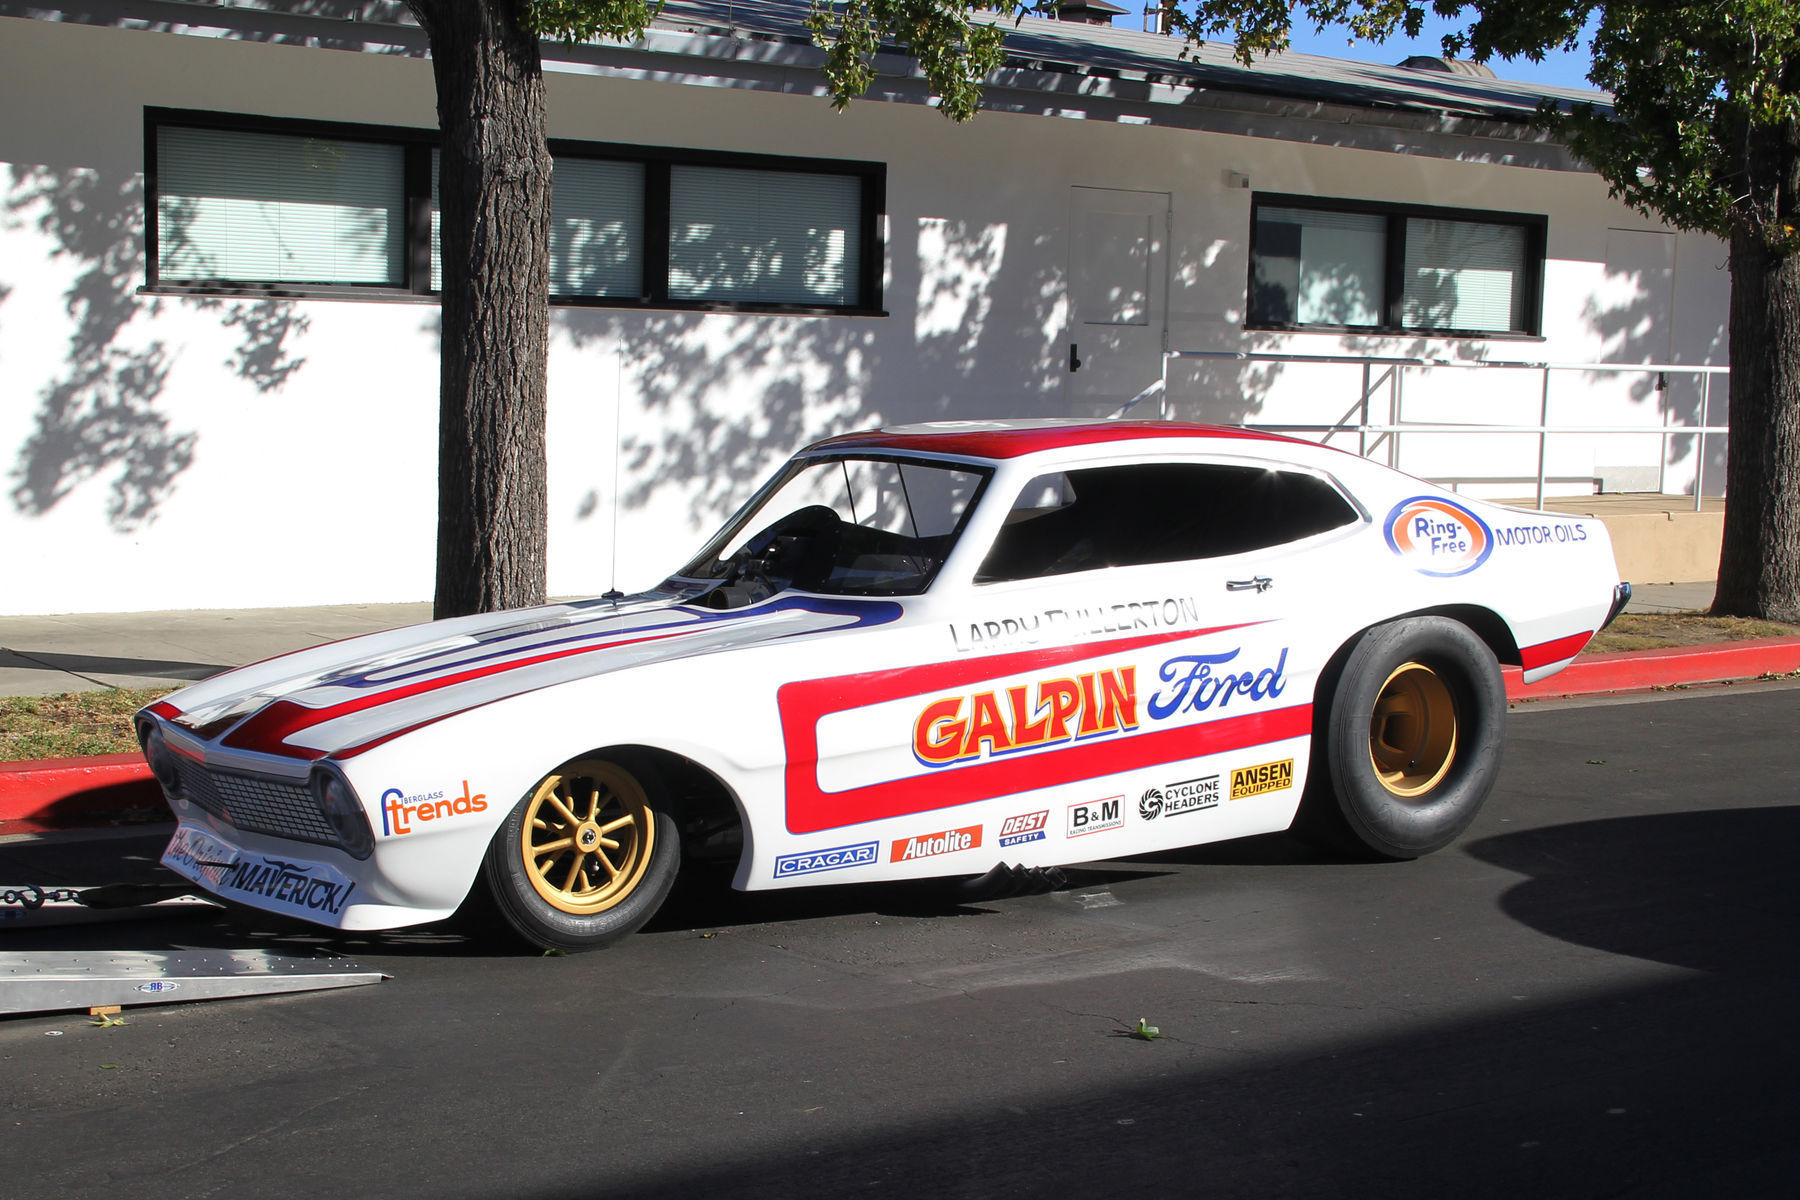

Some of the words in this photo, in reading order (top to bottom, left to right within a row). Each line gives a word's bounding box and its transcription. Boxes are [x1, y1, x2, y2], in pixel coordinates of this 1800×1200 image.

[1414, 517, 1462, 539] Ring-
[1495, 526, 1552, 546] MOTOR
[1555, 524, 1587, 543] OILS
[1431, 537, 1466, 556] Free
[912, 665, 1140, 768] GALPIN
[1148, 647, 1289, 720] Ford
[1233, 762, 1292, 788] ANSEN
[1165, 780, 1220, 800] CYCLONE
[1232, 779, 1291, 798] EQUIPPED
[1164, 792, 1219, 812] HEADERS
[1002, 811, 1047, 834] DEIST
[902, 831, 972, 860] Autolite
[1004, 832, 1039, 846] SAFETY
[781, 849, 871, 872] CRAGAR
[230, 857, 356, 915] MAVERICK!
